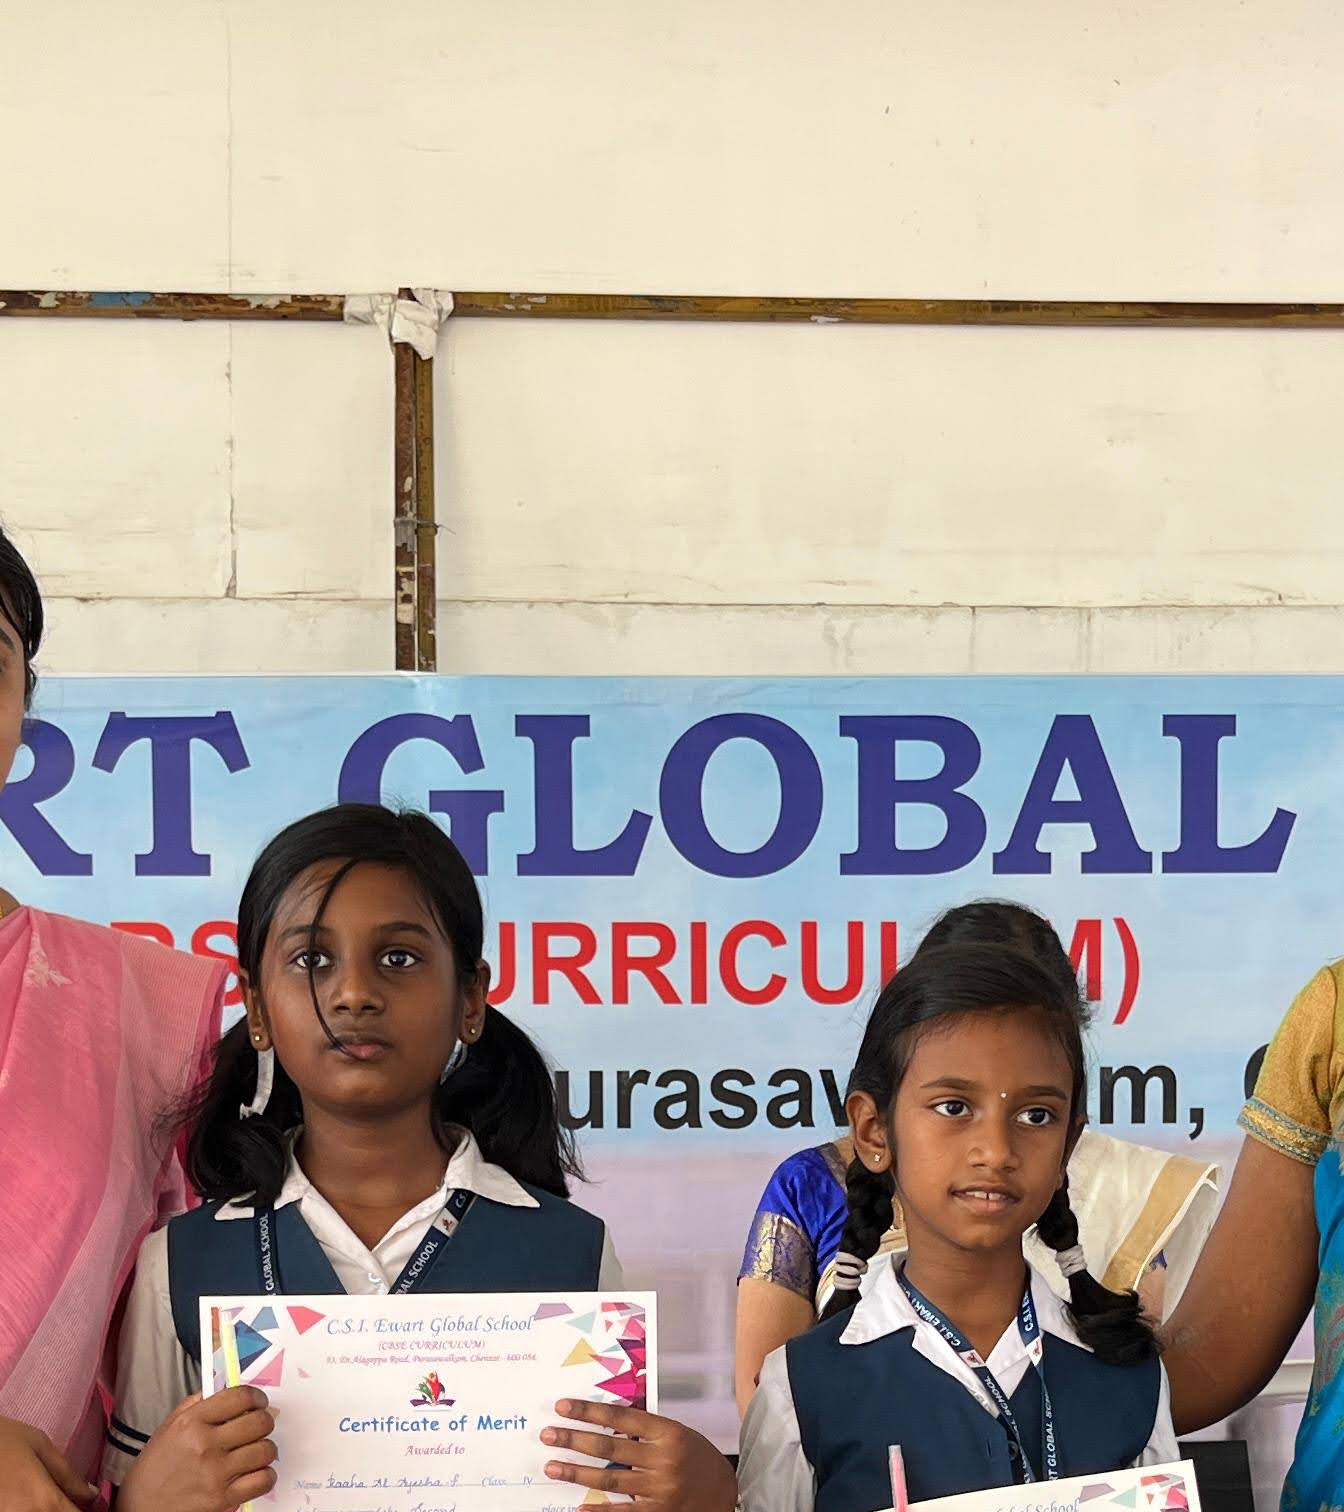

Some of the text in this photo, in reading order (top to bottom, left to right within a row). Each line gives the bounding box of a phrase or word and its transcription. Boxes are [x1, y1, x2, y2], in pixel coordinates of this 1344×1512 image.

[337, 712, 1298, 879] GLOBAL
[260, 1213, 270, 1253] SCHOOL
[408, 1241, 439, 1279] SCHOOL
[374, 1318, 425, 1333] Ewart
[430, 1316, 479, 1336] Global
[483, 1313, 536, 1333] School
[339, 1414, 528, 1434] Certificate of Merit
[405, 1444, 466, 1457] Awarded to
